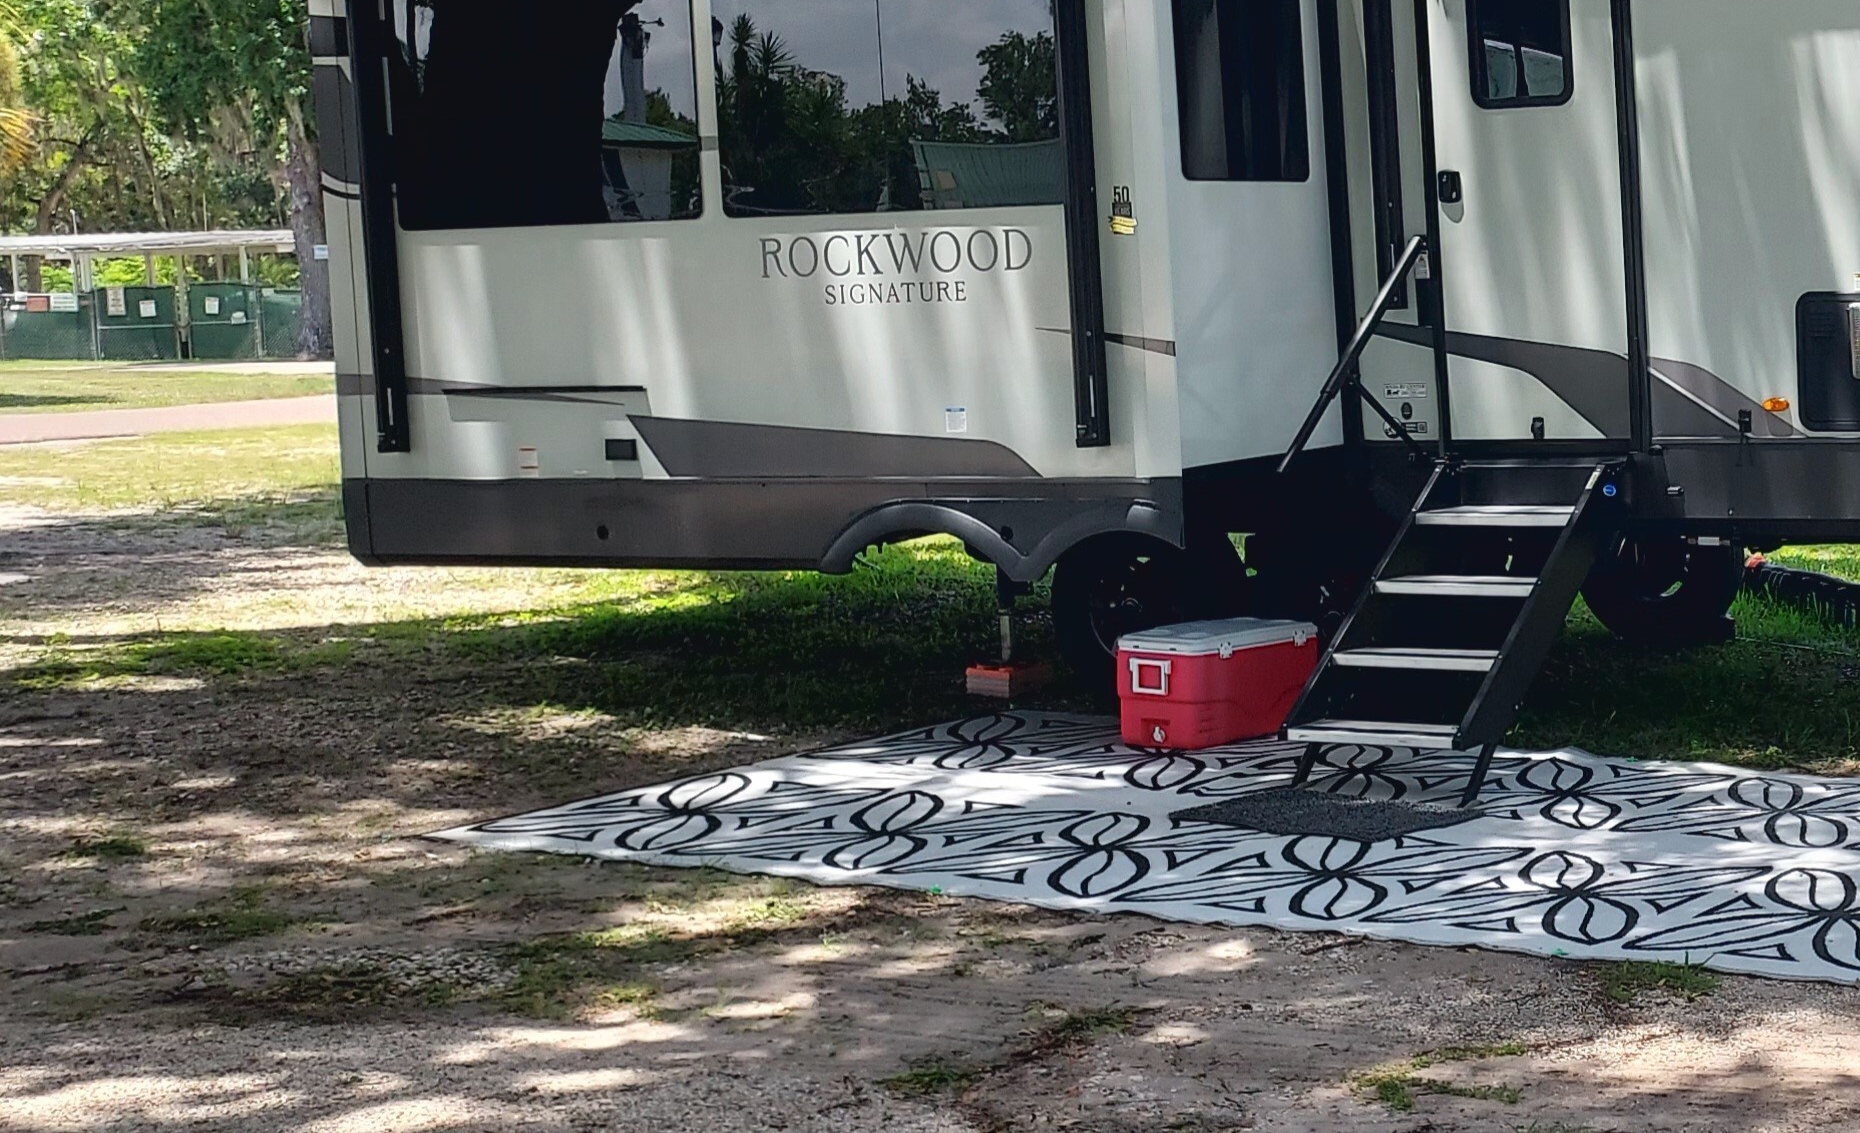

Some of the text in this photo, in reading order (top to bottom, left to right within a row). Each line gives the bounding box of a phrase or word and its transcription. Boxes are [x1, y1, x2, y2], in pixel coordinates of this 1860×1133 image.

[1113, 186, 1130, 203] 50
[759, 229, 1033, 279] ROCKWOOD
[824, 281, 968, 305] SIGNATURE
